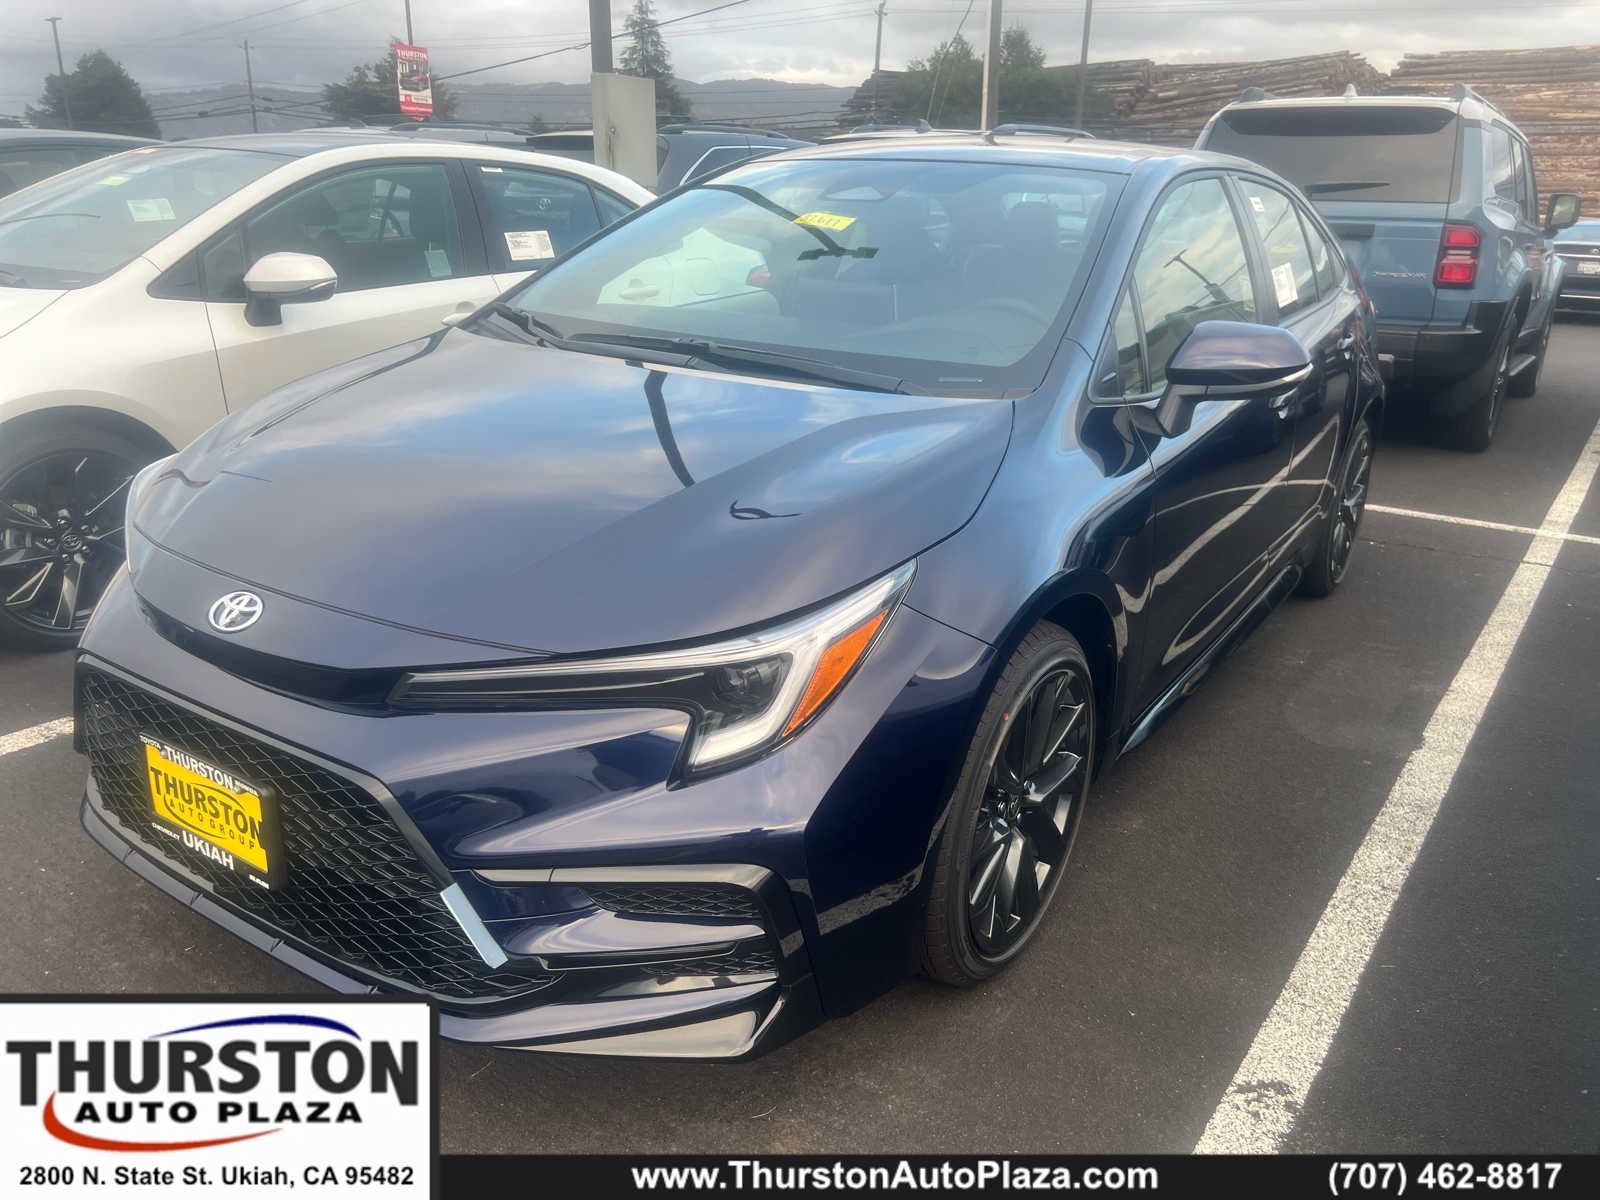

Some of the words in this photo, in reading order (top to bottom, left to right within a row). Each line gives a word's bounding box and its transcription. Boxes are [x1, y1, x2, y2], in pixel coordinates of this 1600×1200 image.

[164, 745, 233, 790] THURSTON
[150, 766, 263, 840] THURSTON
[170, 799, 204, 823] AUTO
[209, 821, 255, 850] GROUP
[182, 830, 234, 871] UKIAH
